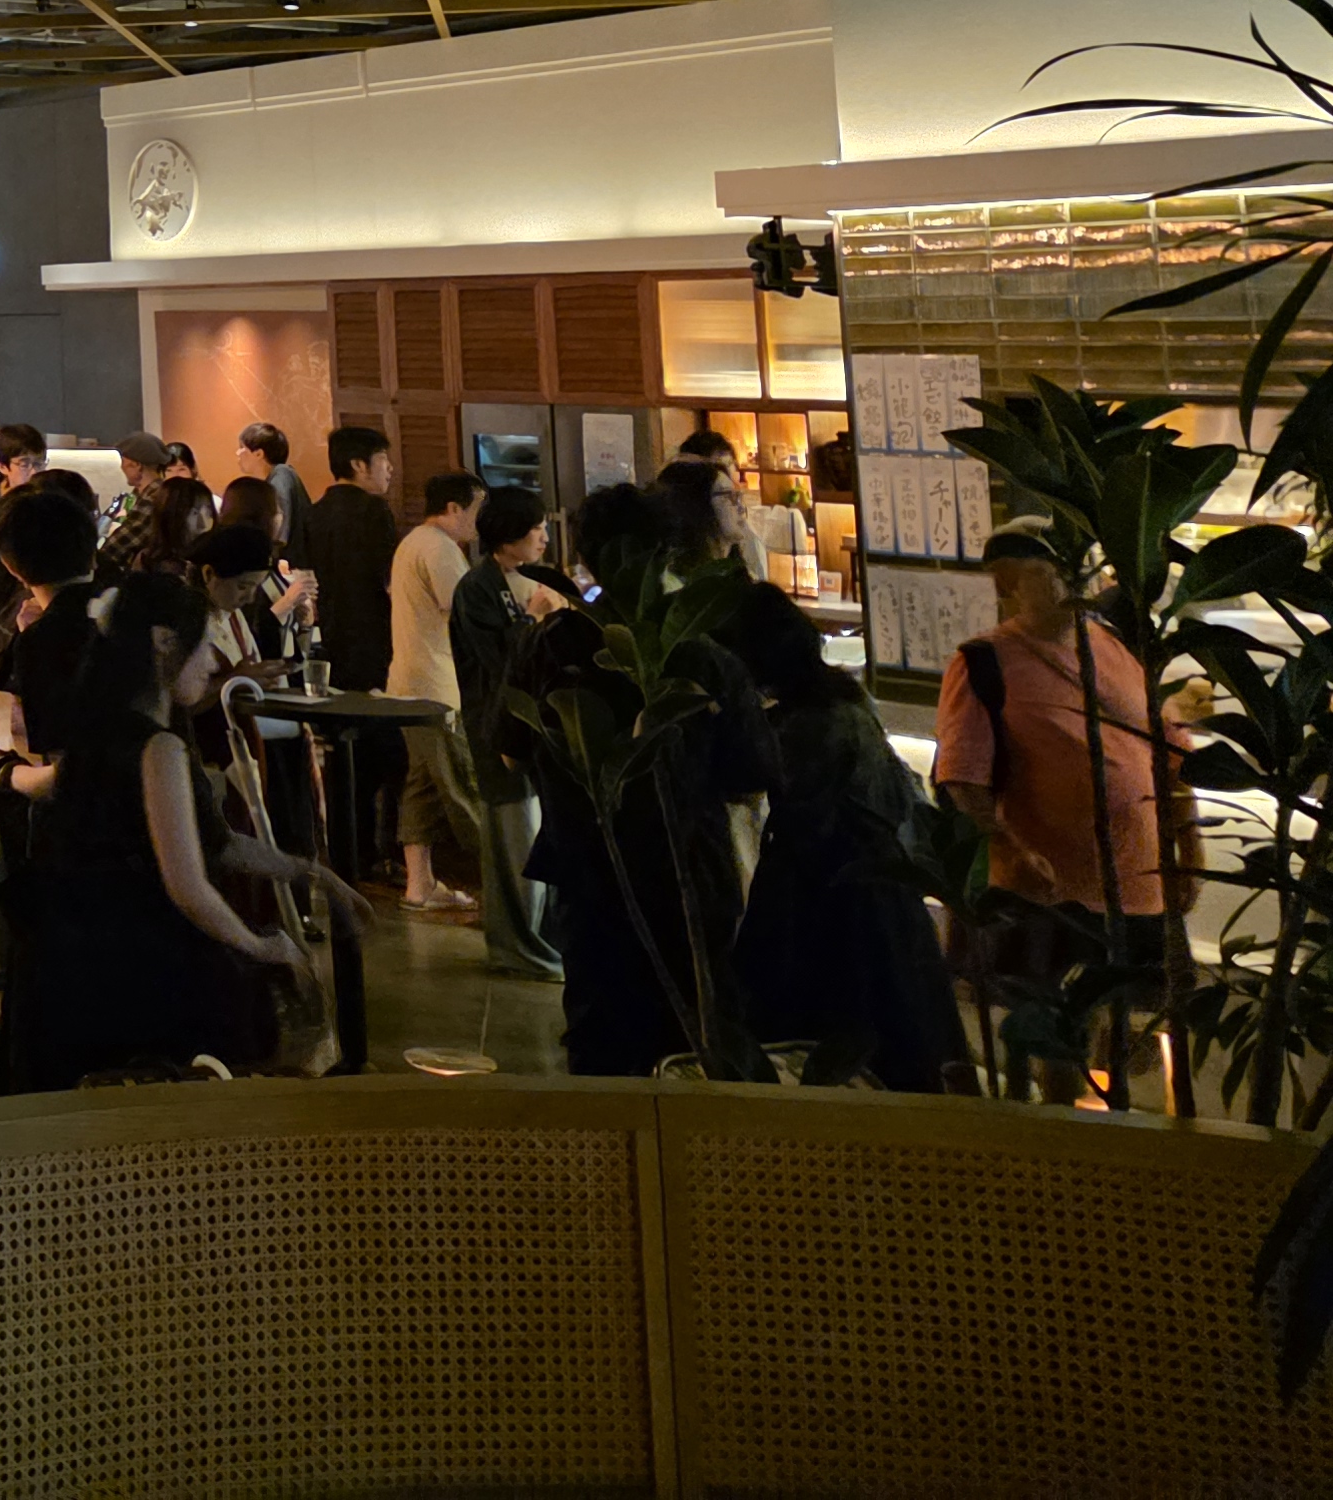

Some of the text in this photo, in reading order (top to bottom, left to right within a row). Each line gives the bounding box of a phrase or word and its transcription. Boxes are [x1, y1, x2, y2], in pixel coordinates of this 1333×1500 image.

[929, 480, 951, 551] チャーハン
